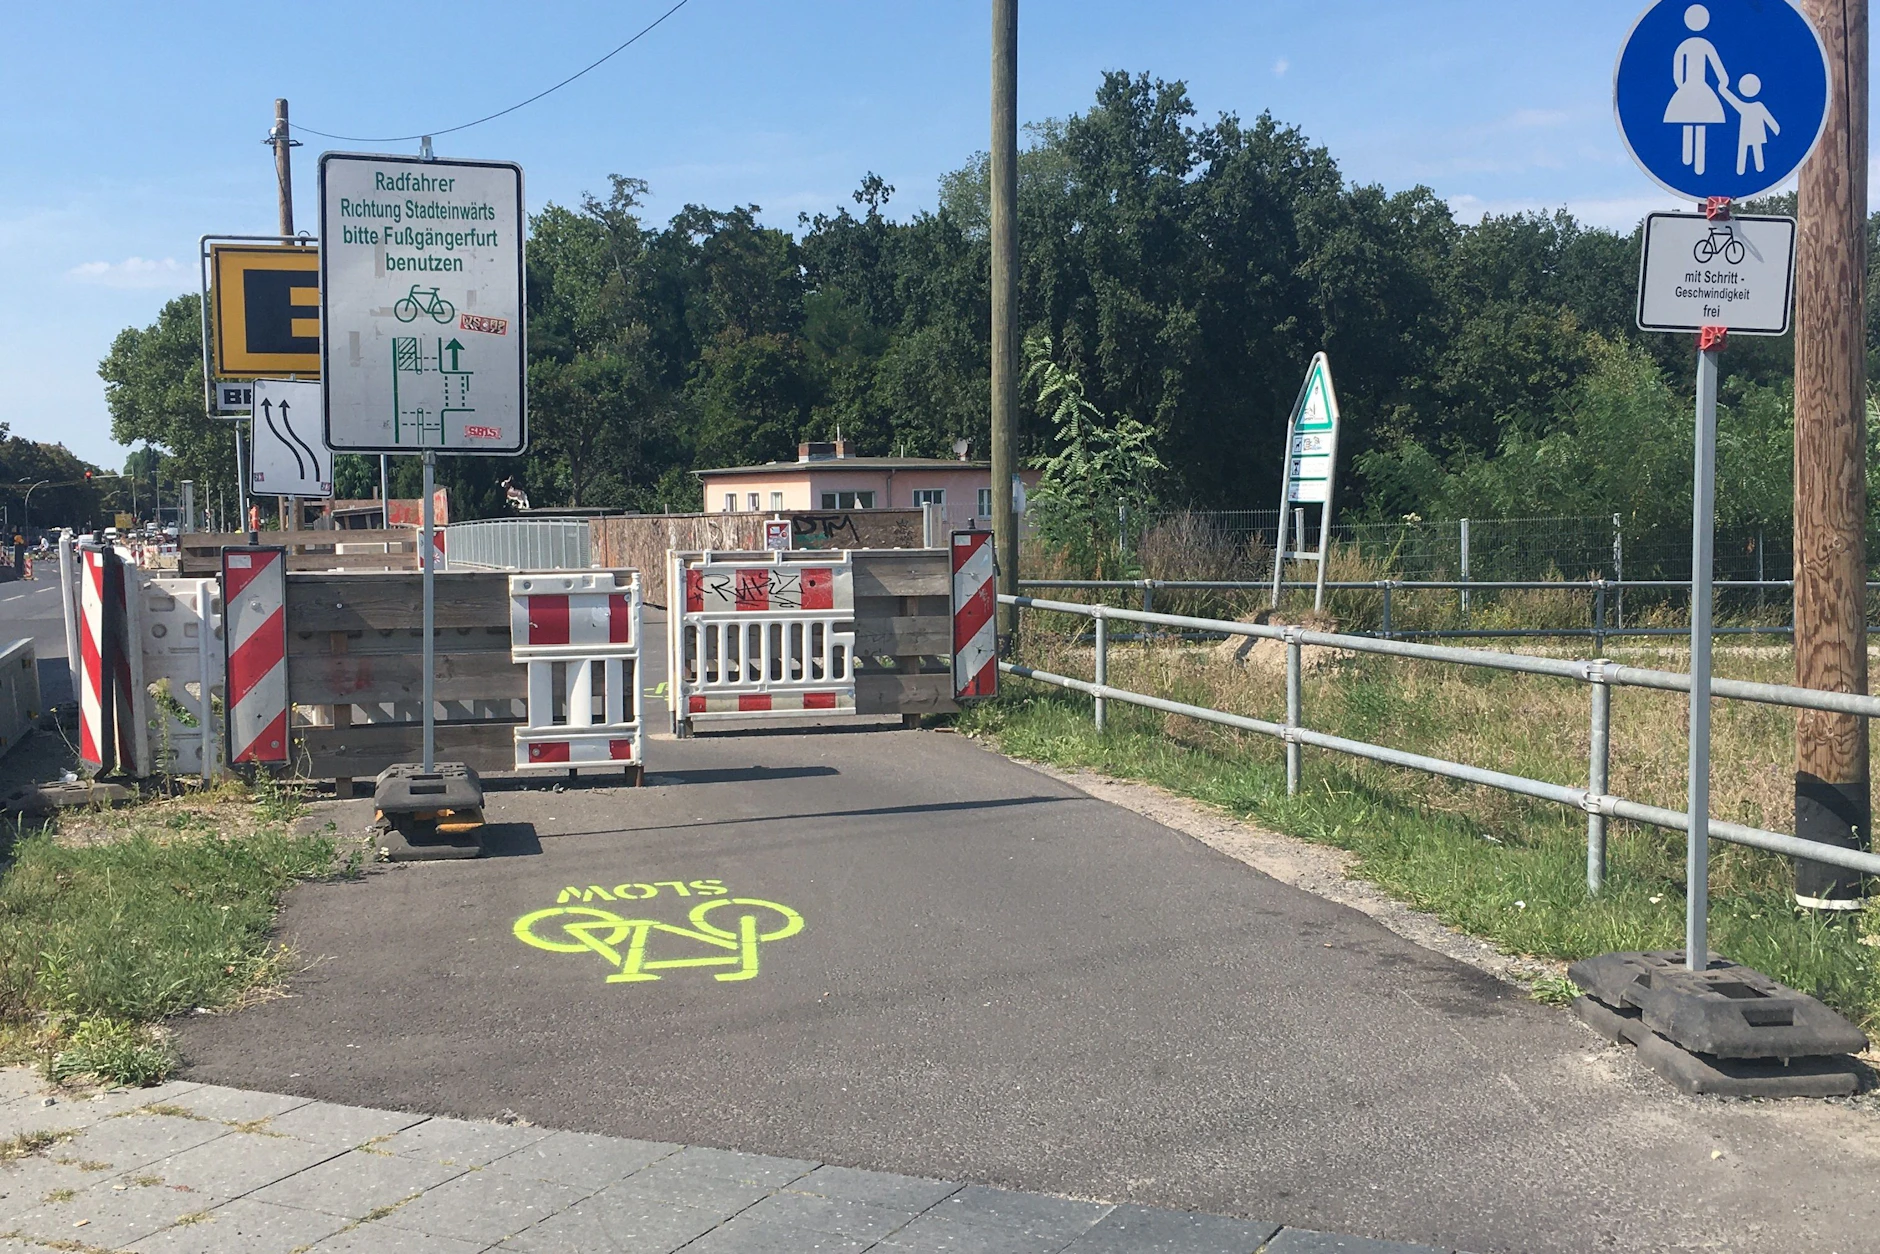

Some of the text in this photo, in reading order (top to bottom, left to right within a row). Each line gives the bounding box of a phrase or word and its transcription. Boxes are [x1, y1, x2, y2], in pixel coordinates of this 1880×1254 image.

[375, 171, 455, 193] Radfahrer
[341, 198, 495, 223] Richtung Stadteinwärts
[343, 225, 498, 250] bitte Fußgängerfurt
[385, 253, 463, 272] benutzen
[1685, 271, 1701, 284] mit
[1675, 286, 1750, 302] Geschwindigkeit
[1703, 304, 1720, 318] frei
[556, 879, 728, 904] SLOW
